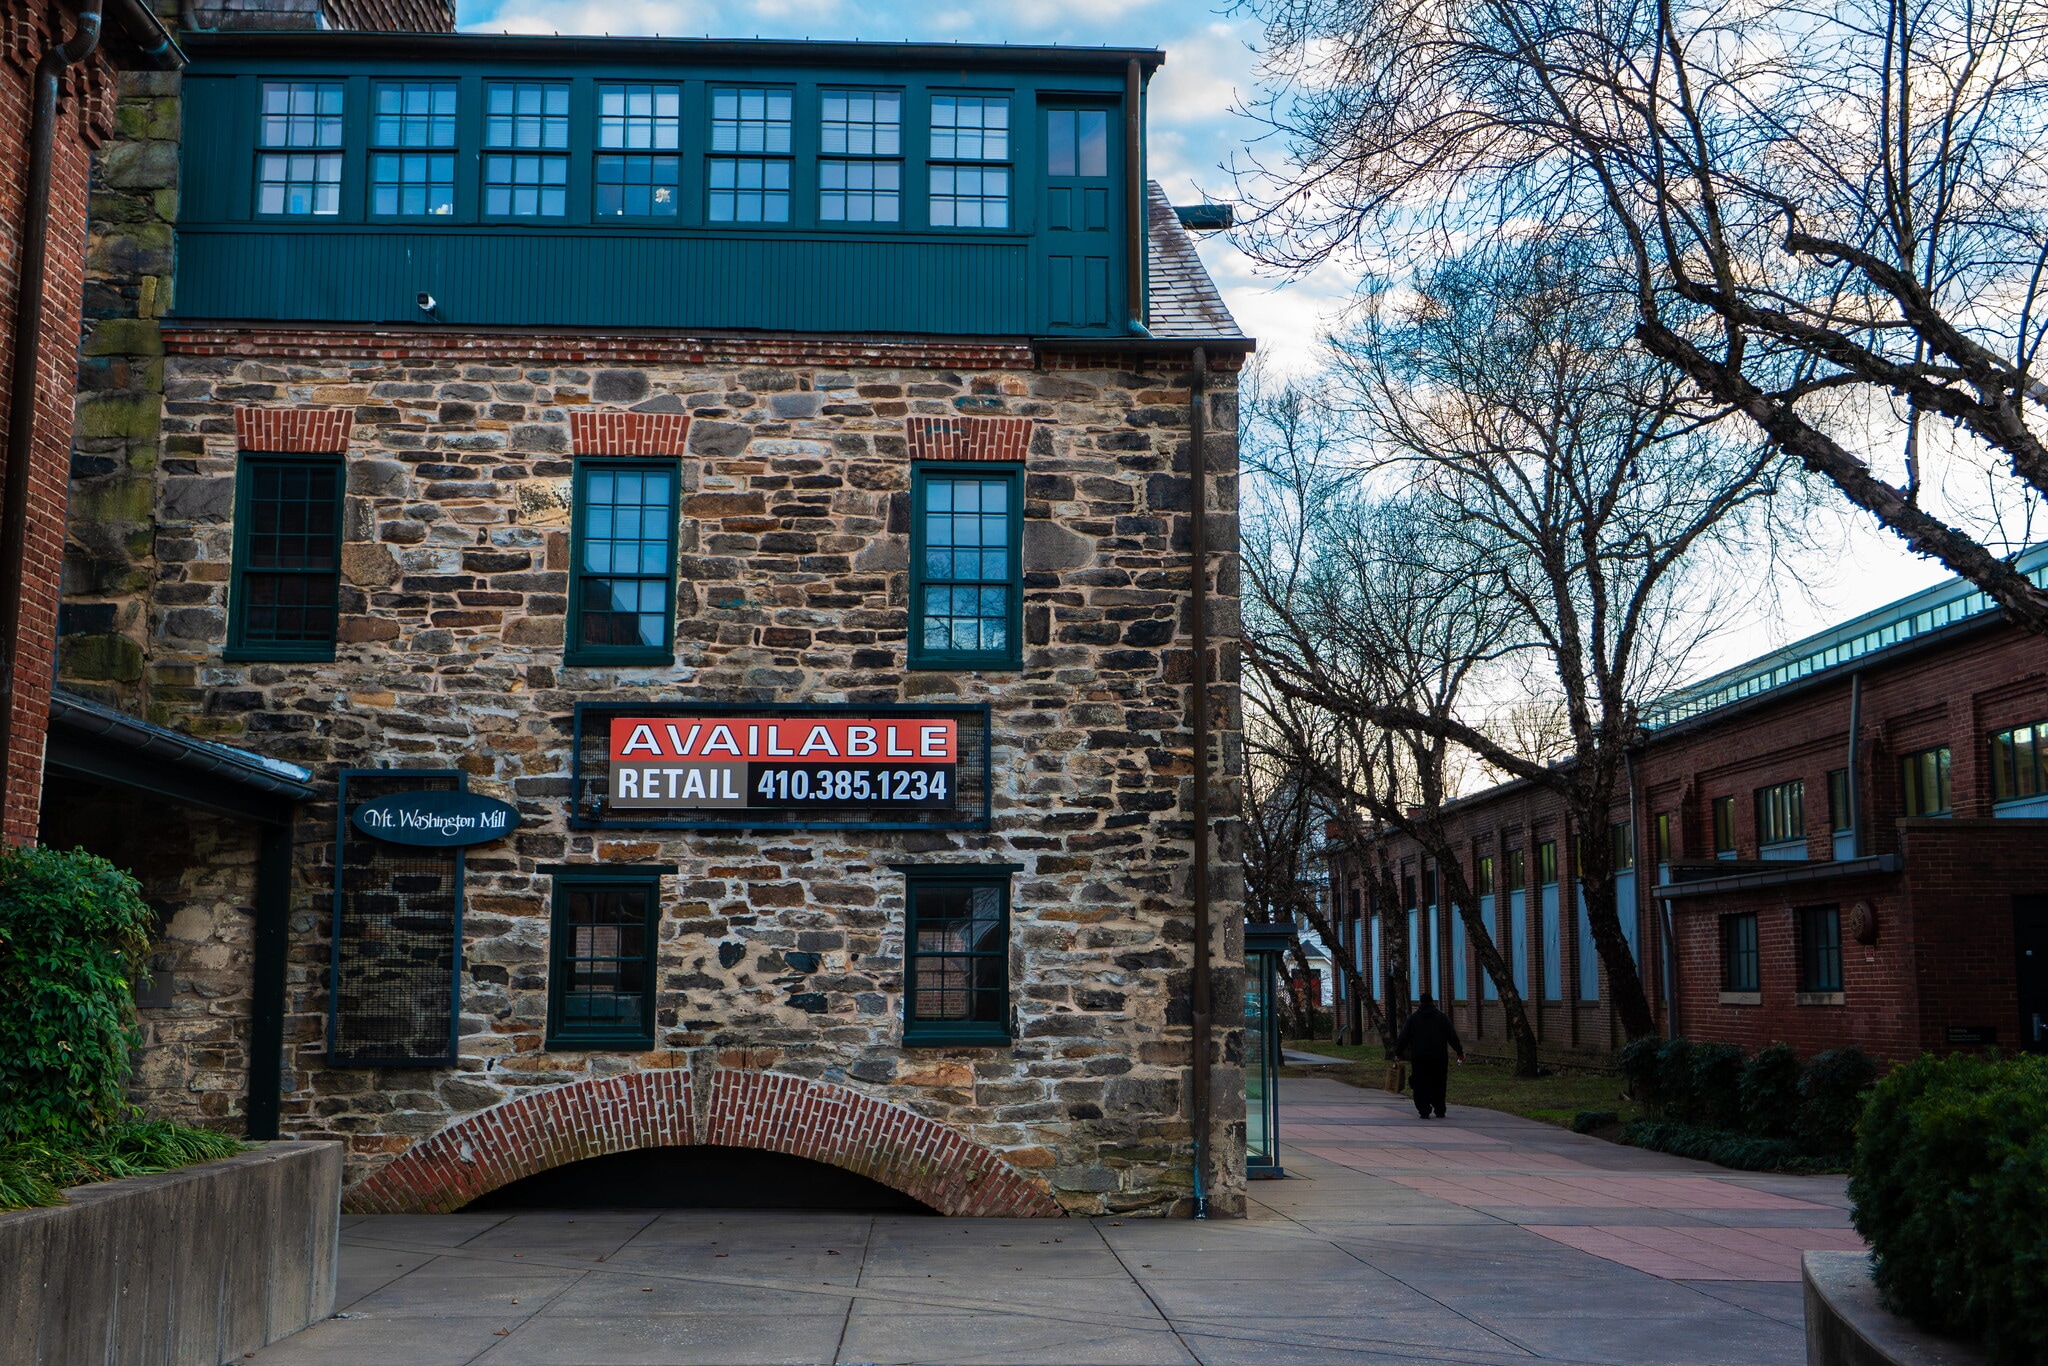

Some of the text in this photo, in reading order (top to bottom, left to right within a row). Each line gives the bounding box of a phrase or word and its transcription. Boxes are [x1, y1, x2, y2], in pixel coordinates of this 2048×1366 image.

[620, 723, 949, 757] AVAILABLE
[618, 767, 947, 800] RETAIL 410.385.1234
[363, 808, 507, 837] Mt. Washington Mill
